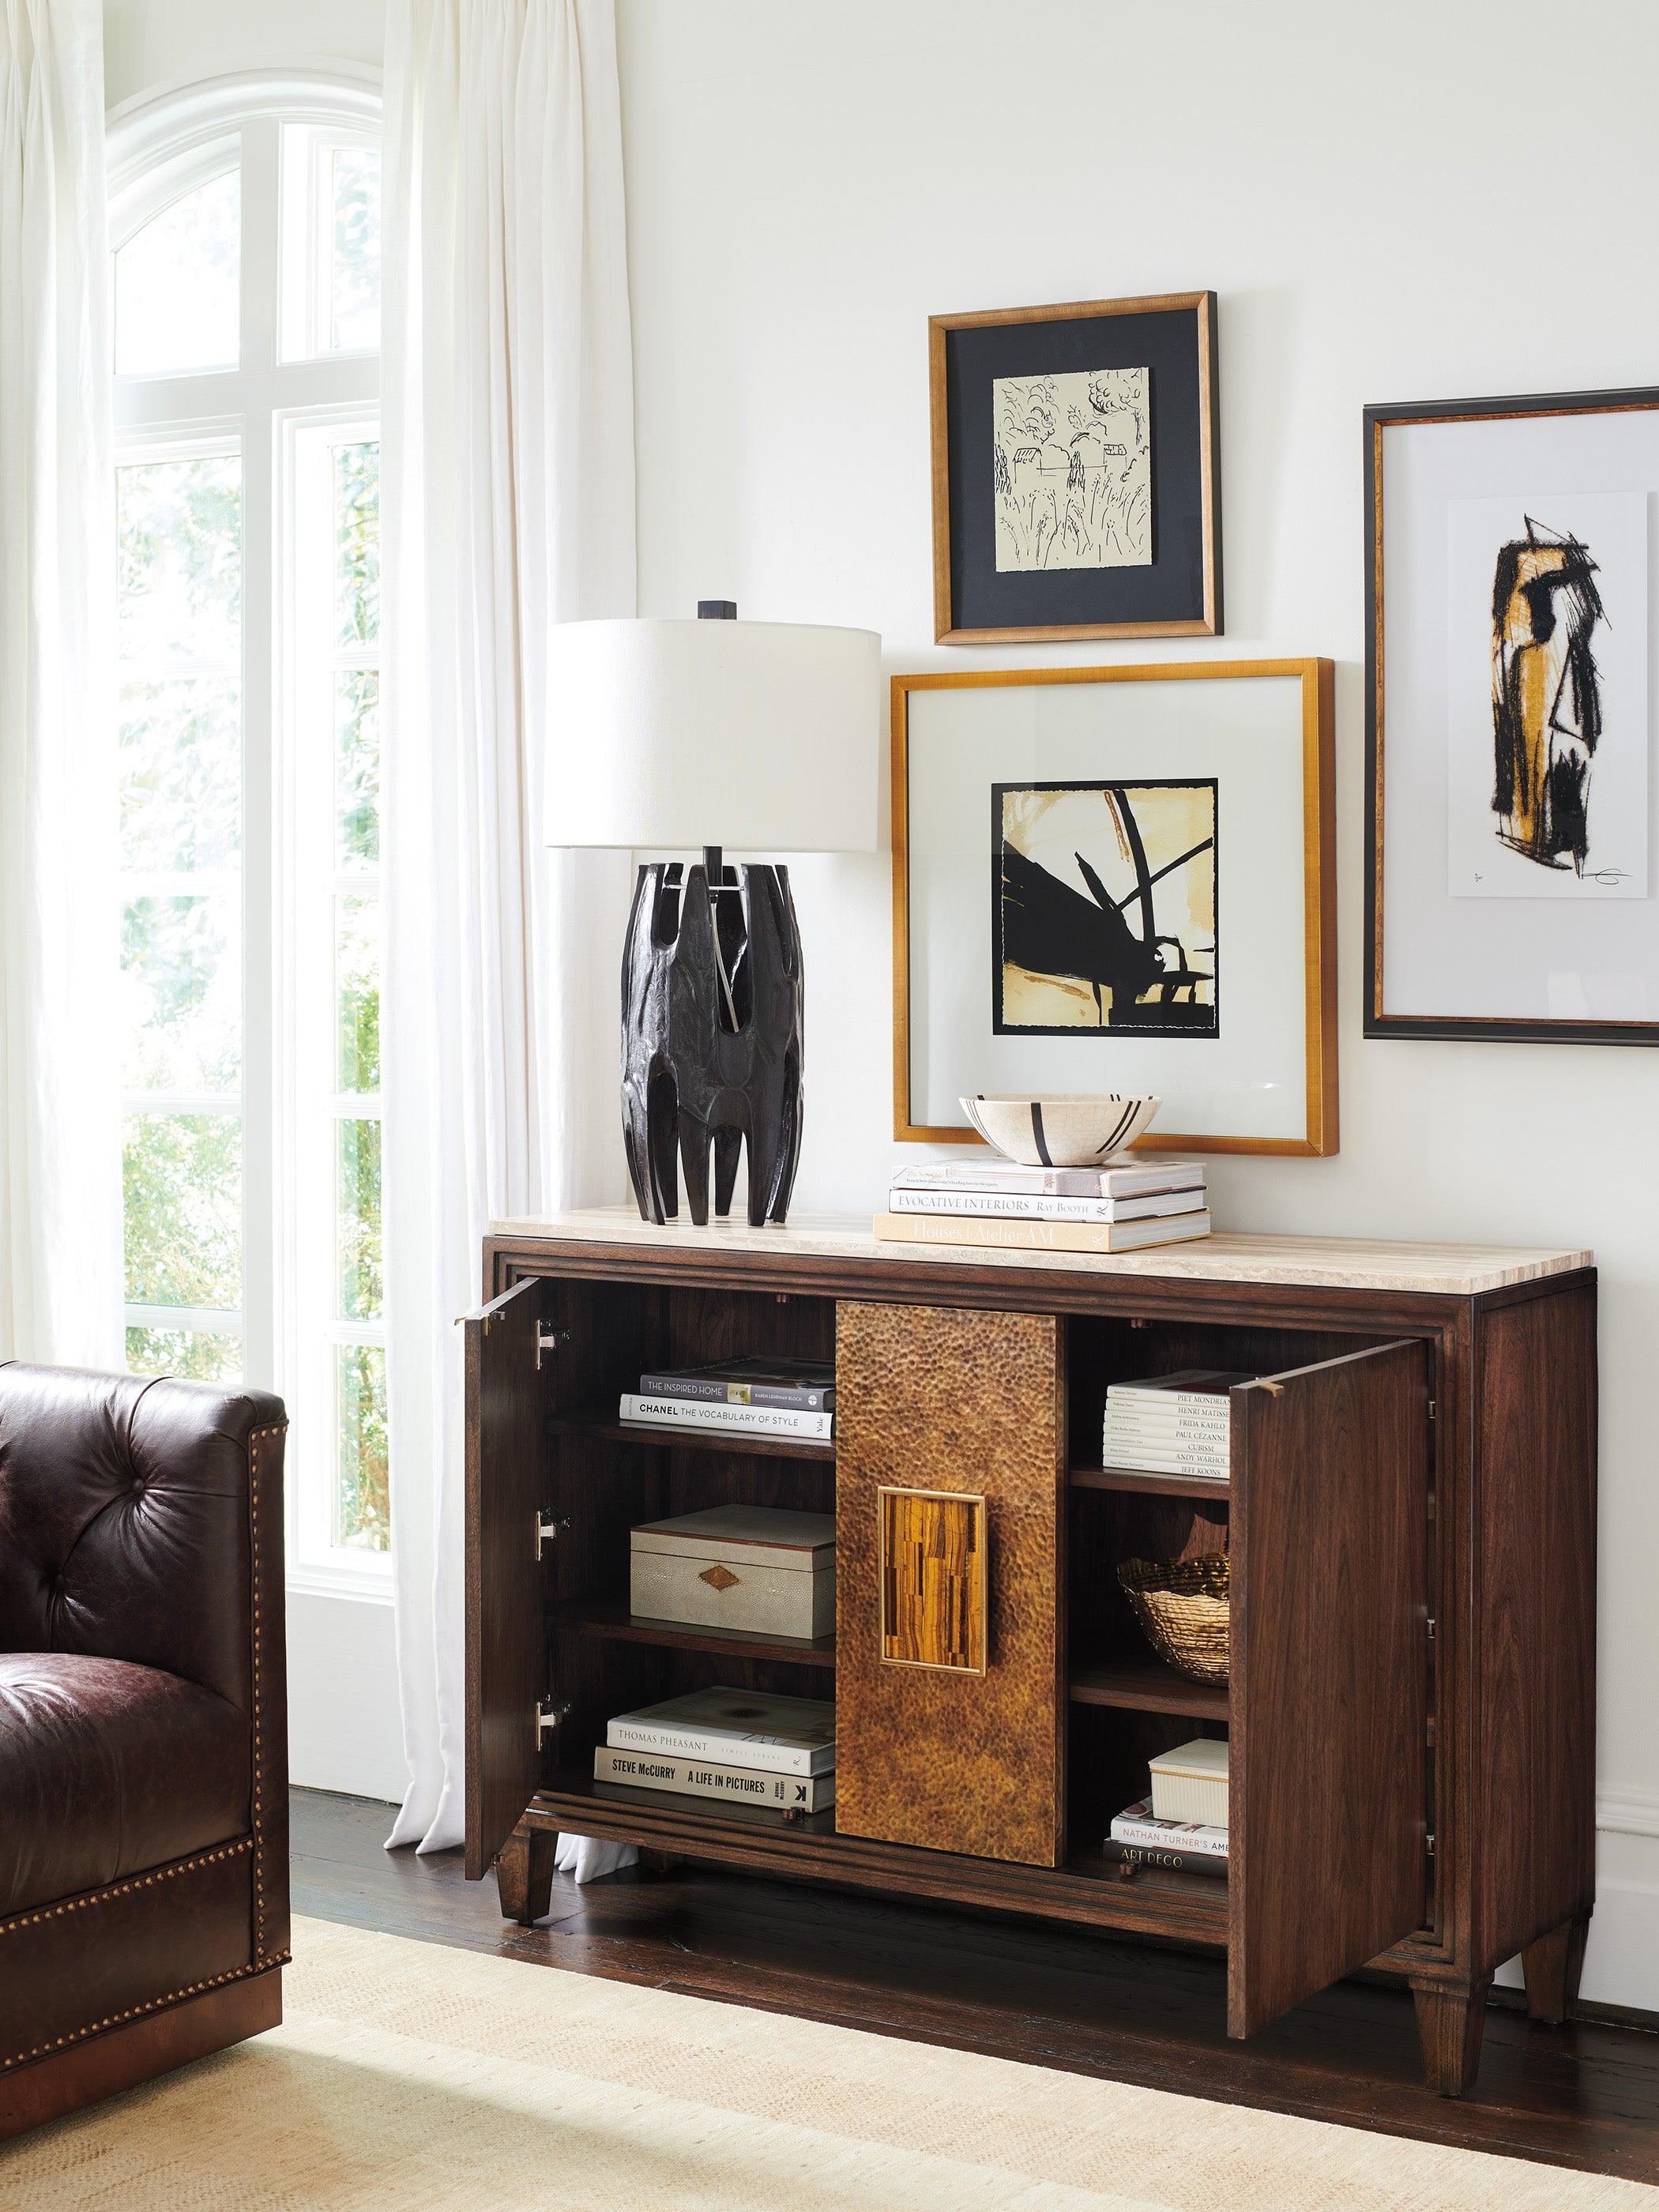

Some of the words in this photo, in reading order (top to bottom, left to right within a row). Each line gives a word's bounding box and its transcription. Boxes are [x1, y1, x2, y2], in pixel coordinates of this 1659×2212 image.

[899, 1196, 962, 1209] EVOCATIVE
[965, 1198, 1029, 1210] INTERIORS
[1056, 1202, 1089, 1213] BOOTH
[914, 1221, 962, 1240] Houses
[976, 1224, 1025, 1243] Atelier
[1028, 1226, 1053, 1244] AM
[648, 1381, 663, 1391] THE
[664, 1382, 698, 1394] INSPIRED
[698, 1386, 722, 1396] HOME
[639, 1404, 678, 1415] CHANEL
[681, 1408, 697, 1417] THE
[698, 1409, 757, 1423] VOCABULARY
[758, 1414, 770, 1424] OF
[772, 1416, 799, 1427] STYLE
[1201, 1421, 1225, 1430] KAHLO
[1187, 1443, 1214, 1452] CUBISM
[1197, 1455, 1227, 1464] WARHOL
[1197, 1467, 1221, 1477] KOONS
[618, 1729, 657, 1744] THOMAS
[660, 1736, 708, 1751] PHEASANT
[612, 1759, 636, 1774] STEVE
[638, 1762, 675, 1780] McCURRY
[687, 1770, 694, 1782] A
[696, 1772, 713, 1785] LIFE
[714, 1774, 724, 1786] IN
[726, 1776, 765, 1793] PICTURES
[1123, 1828, 1160, 1841] NATHAN
[1163, 1834, 1208, 1849] TURNER'S
[1121, 1849, 1144, 1862] ART
[1147, 1852, 1183, 1868] DECO
